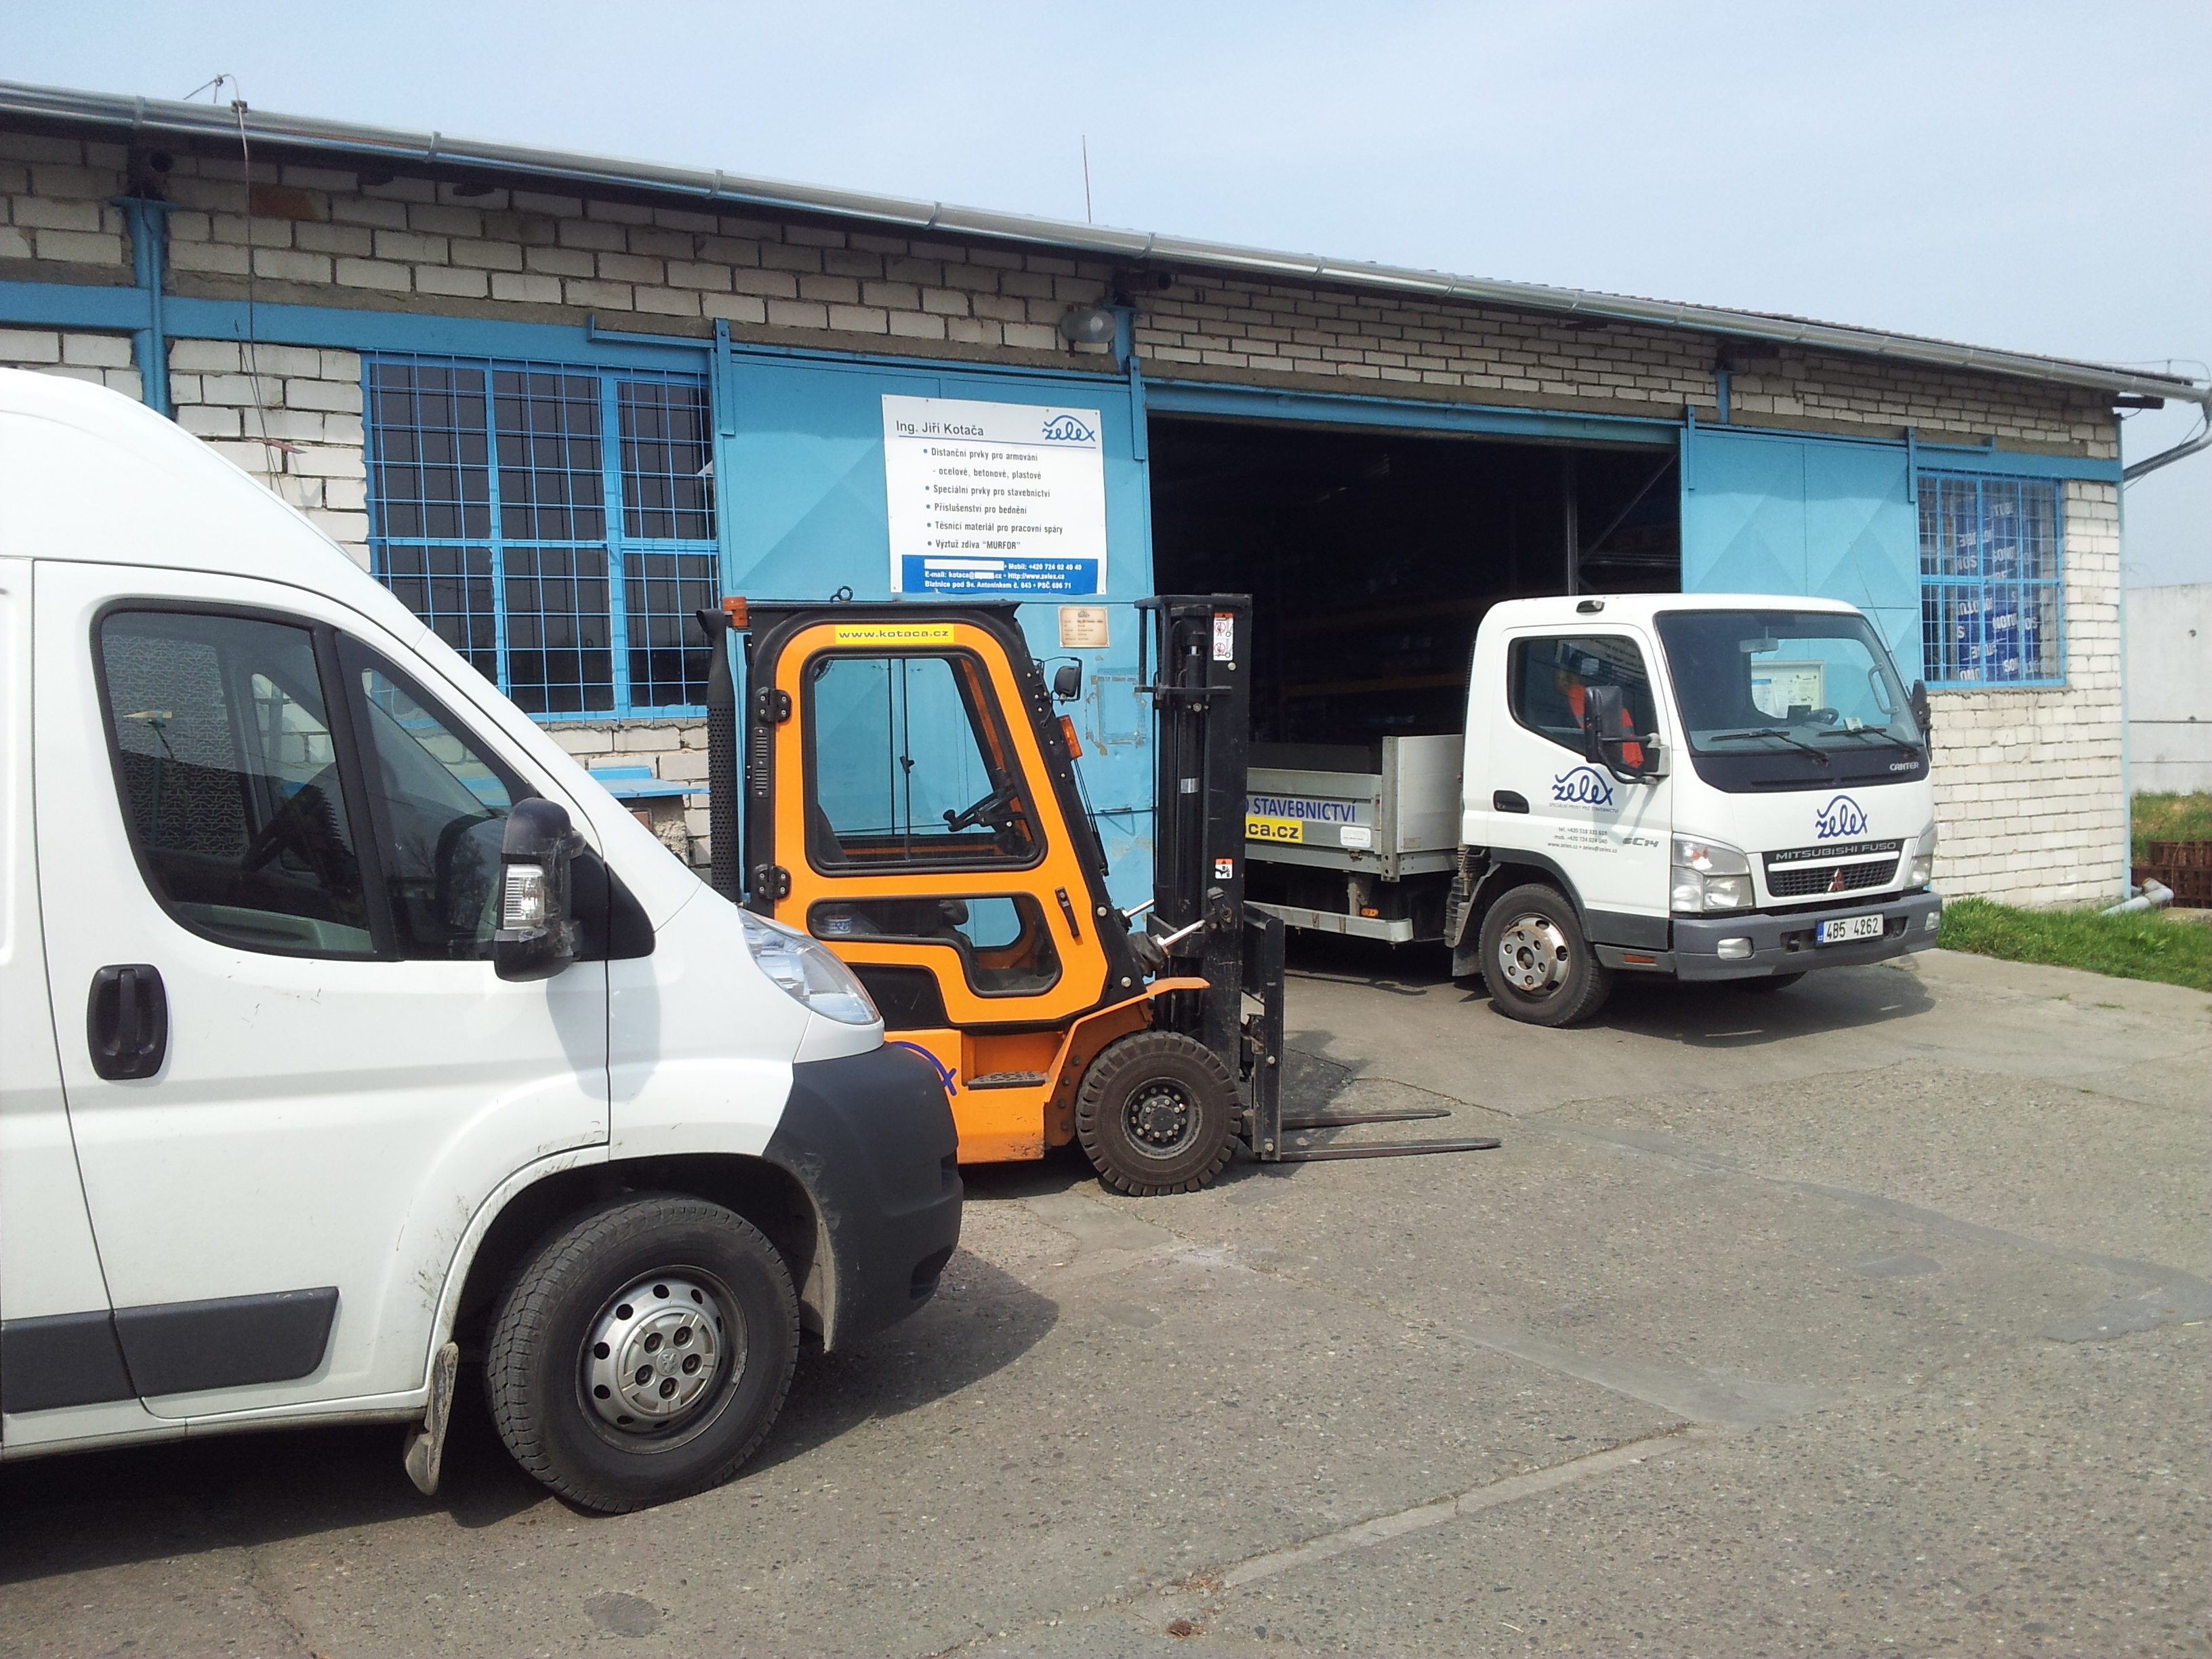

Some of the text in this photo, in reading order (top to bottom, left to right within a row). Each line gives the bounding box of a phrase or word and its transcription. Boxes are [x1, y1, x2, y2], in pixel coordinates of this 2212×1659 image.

[896, 420, 984, 436] Ing. Jiří Kotača
[931, 447, 1038, 462] Distanční prvky pro armování
[939, 468, 1042, 480] ocelové, betonové, plastové
[933, 485, 1050, 497] Speciální prvky pro stavebnictví
[934, 503, 1027, 515] Příslušenství pro bednění
[935, 521, 1063, 535] Těsnící materiál pro pracovní spáry
[935, 539, 959, 550] Výztuž
[961, 540, 980, 549] zdiva
[838, 630, 949, 638] www.kotaca.cz
[1889, 761, 1919, 771] CANTER
[1254, 798, 1356, 823] STAVEBNICTVÍ
[1247, 823, 1299, 840] ca.cz
[1776, 842, 1896, 861] MITSUBISHI FUSO
[1826, 922, 1846, 940] 4B5
[1854, 917, 1879, 937] 4262
